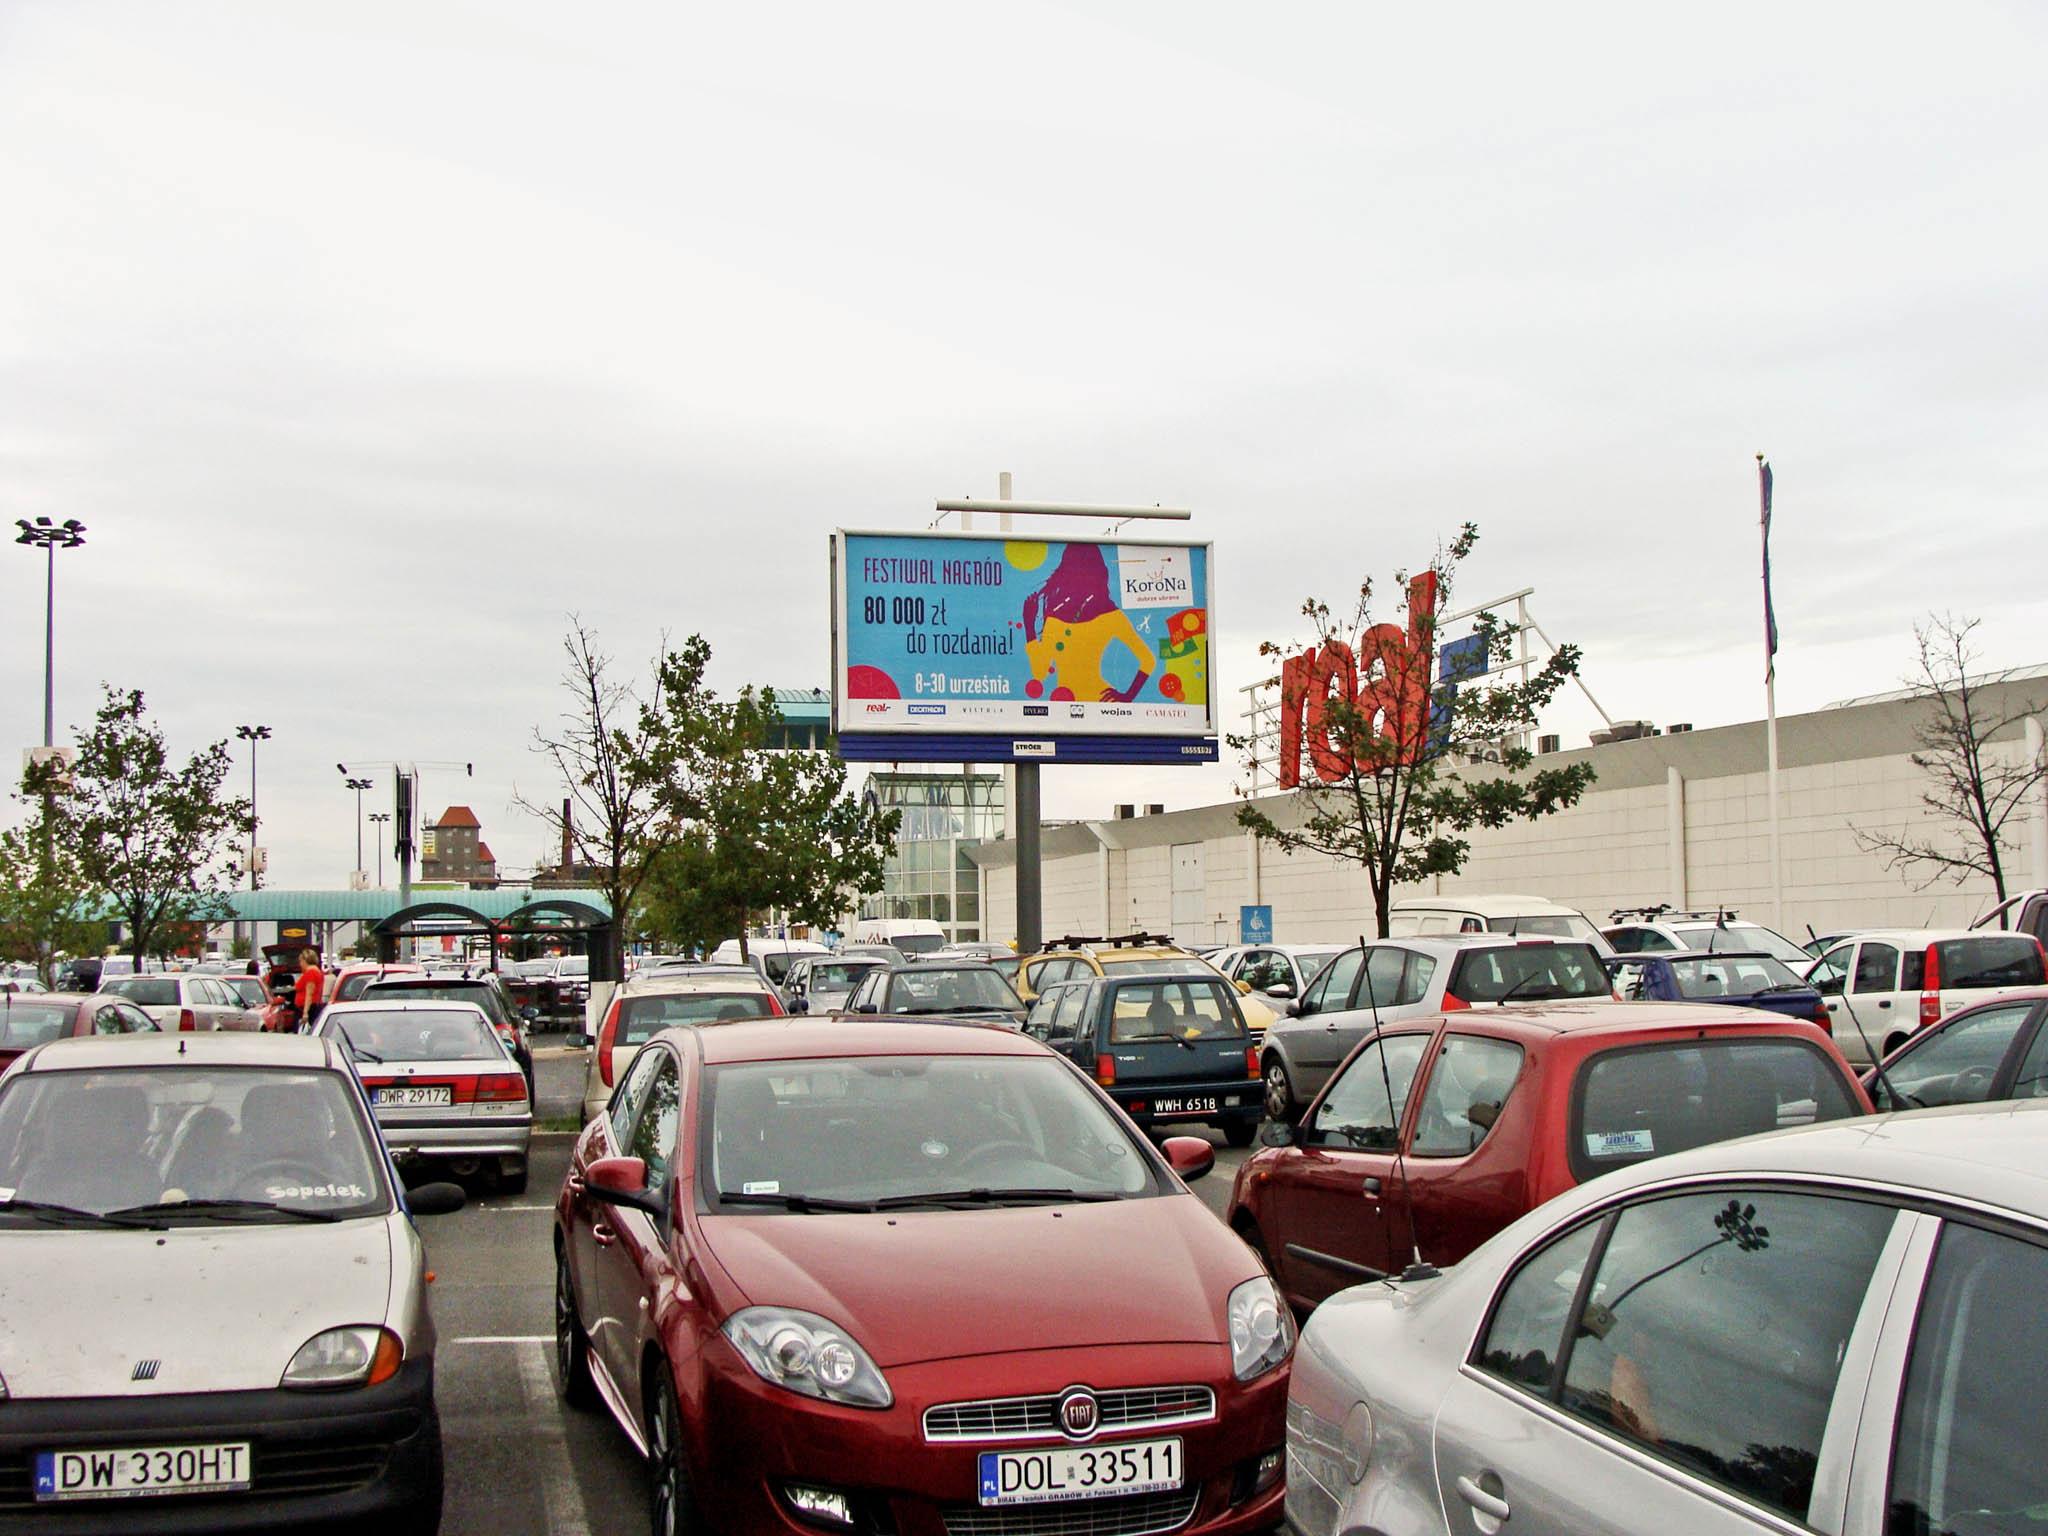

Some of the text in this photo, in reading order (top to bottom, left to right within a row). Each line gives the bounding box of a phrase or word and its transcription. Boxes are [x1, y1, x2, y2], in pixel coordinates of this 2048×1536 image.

[864, 556, 1003, 587] FESTIWAL NAGRÓD
[1126, 577, 1187, 593] KoroNa
[864, 596, 948, 626] 80 000 zł
[906, 626, 1013, 656] do rozdania!
[915, 672, 1011, 695] 8-30 września
[1100, 707, 1133, 717] wojas
[379, 1088, 449, 1105] DWR 29172
[1154, 1097, 1216, 1112] WWH 6518
[264, 1183, 367, 1200] Sopelek
[1069, 1404, 1091, 1425] FIAT
[62, 1446, 244, 1489] DW 330HT
[1002, 1444, 1173, 1492] DOL 33511
[40, 1477, 52, 1487] PL
[984, 1480, 997, 1491] PL
